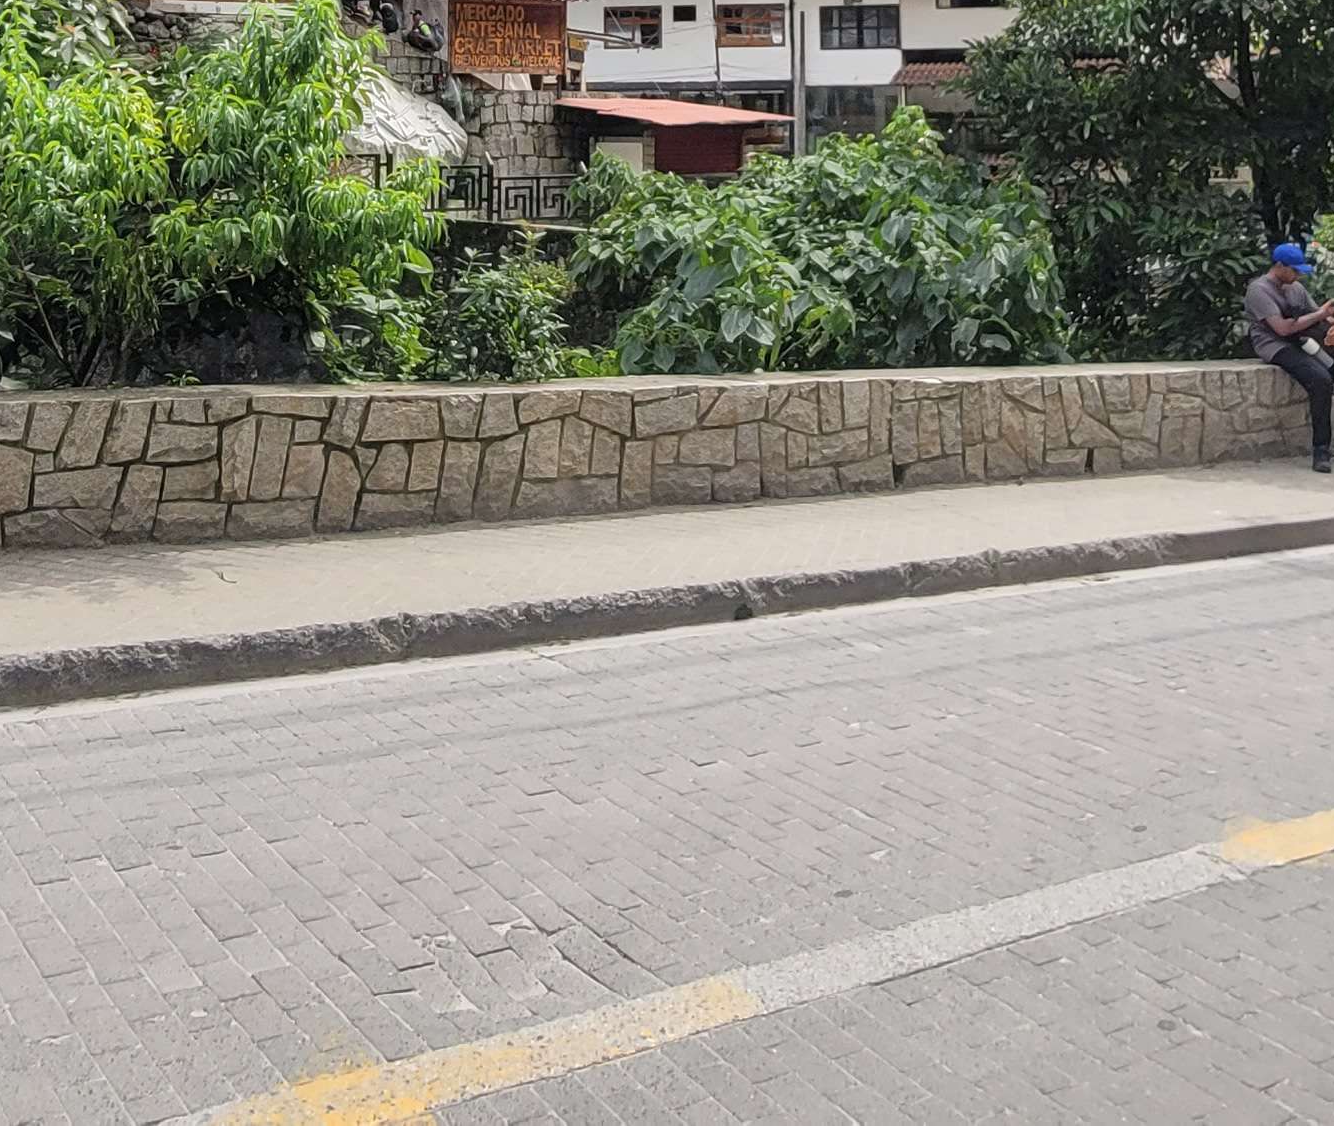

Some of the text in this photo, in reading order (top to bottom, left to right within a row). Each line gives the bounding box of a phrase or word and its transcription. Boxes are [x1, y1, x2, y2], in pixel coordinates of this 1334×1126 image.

[455, 3, 525, 22] MERCADO
[457, 21, 541, 39] ARTESANAL
[454, 37, 562, 56] CRAFT MARKET
[454, 55, 562, 68] BIENVENIDOS WELCOME
